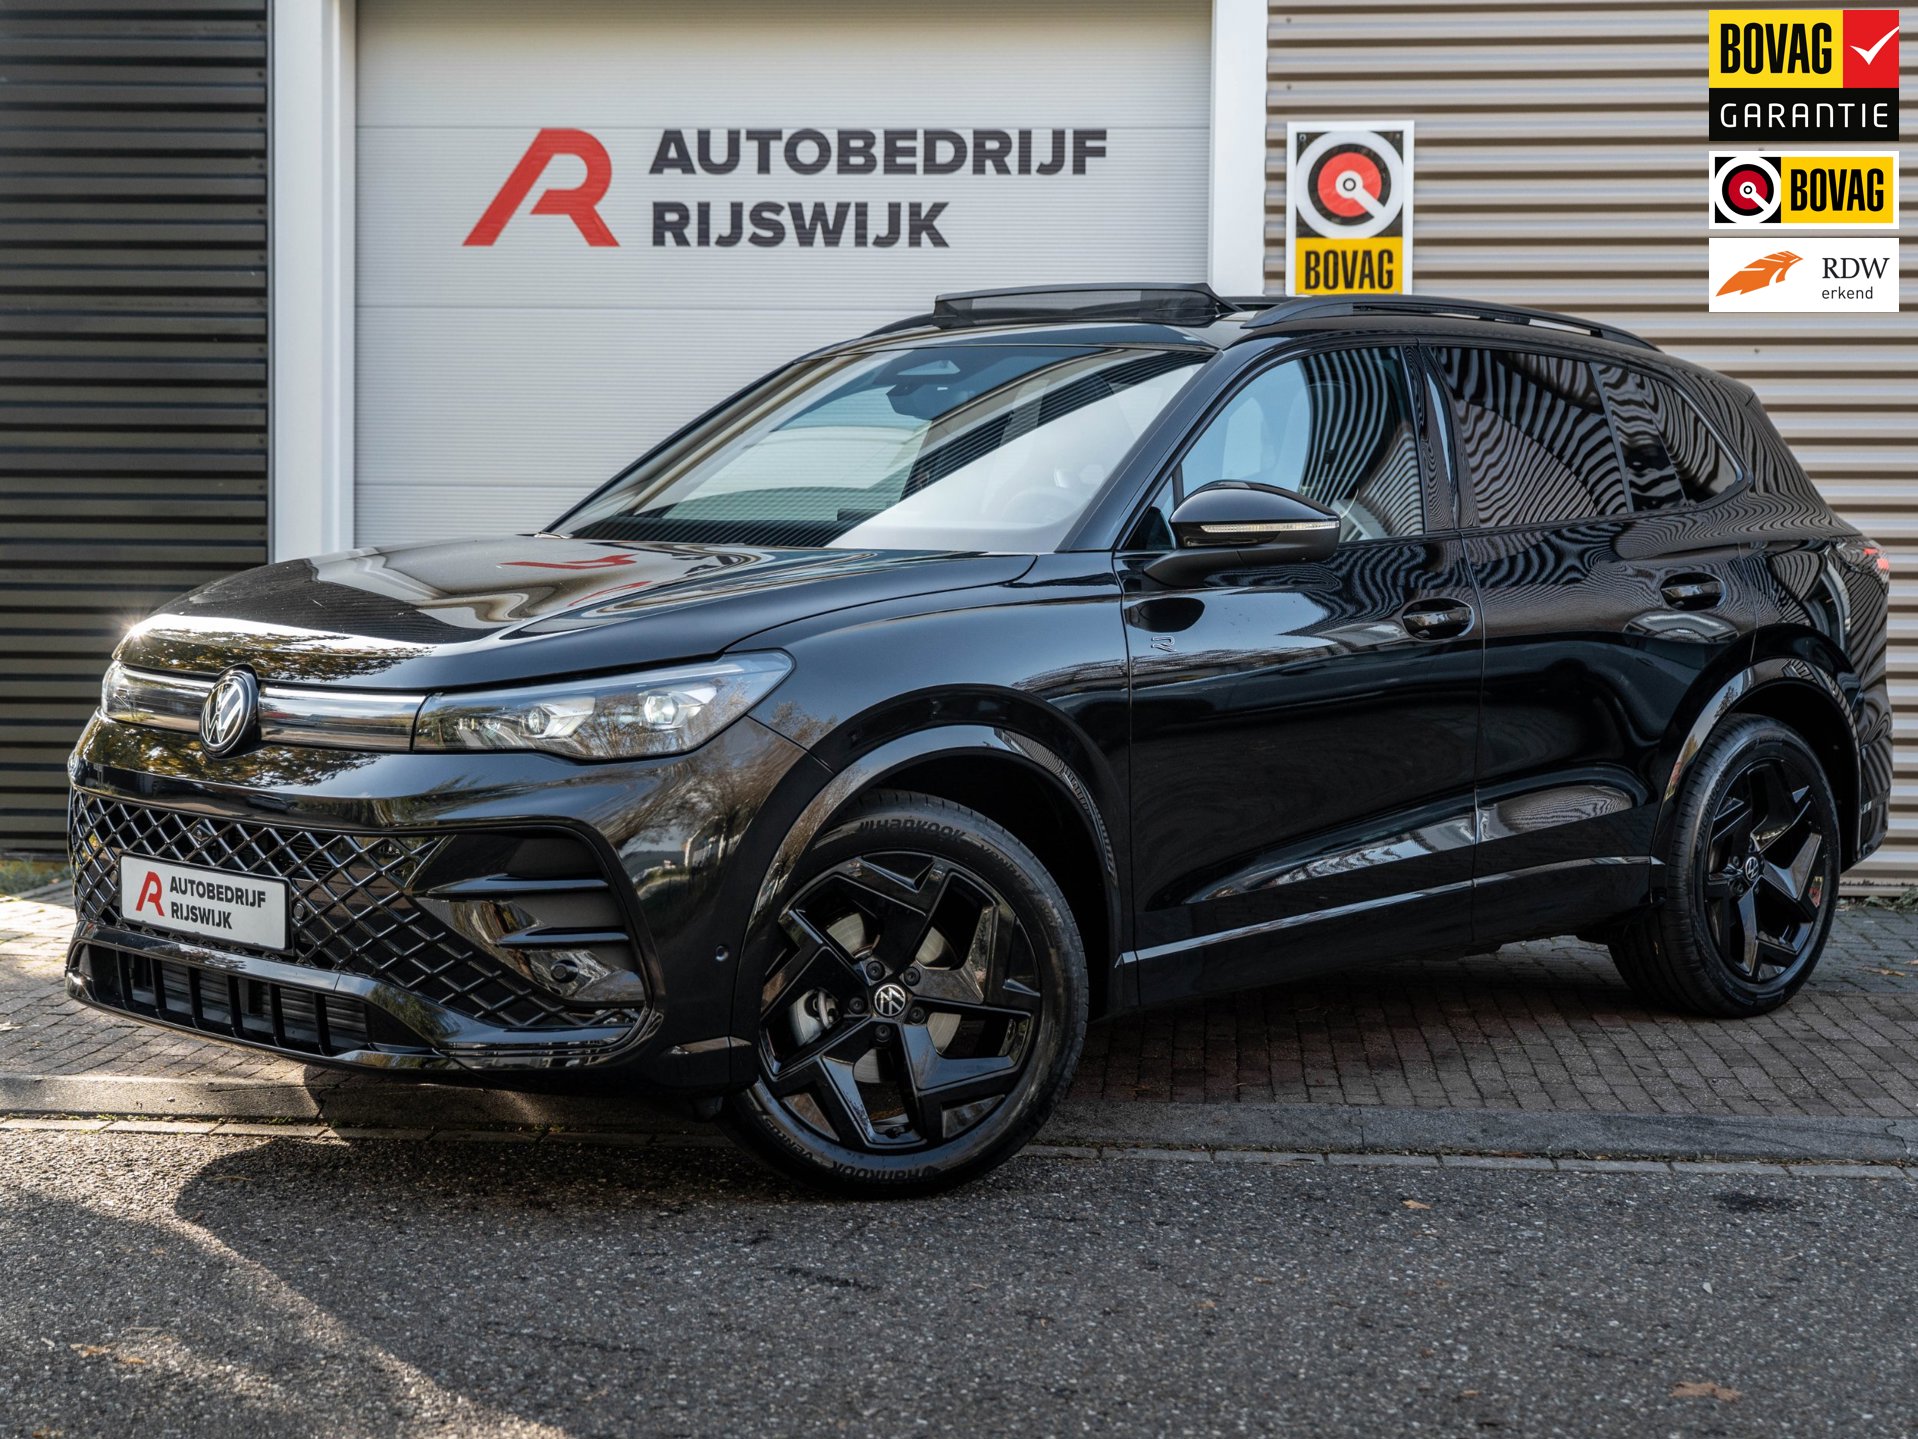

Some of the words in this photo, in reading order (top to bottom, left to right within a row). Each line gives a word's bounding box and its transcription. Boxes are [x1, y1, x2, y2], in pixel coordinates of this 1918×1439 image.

[648, 128, 1108, 176] AUTOBEDRIJF
[651, 201, 950, 248] RIJSWIJK
[1304, 248, 1394, 290] BOVAG
[169, 875, 266, 908] AUTOBEDRIJF
[170, 901, 233, 930] RIJSWIJK
